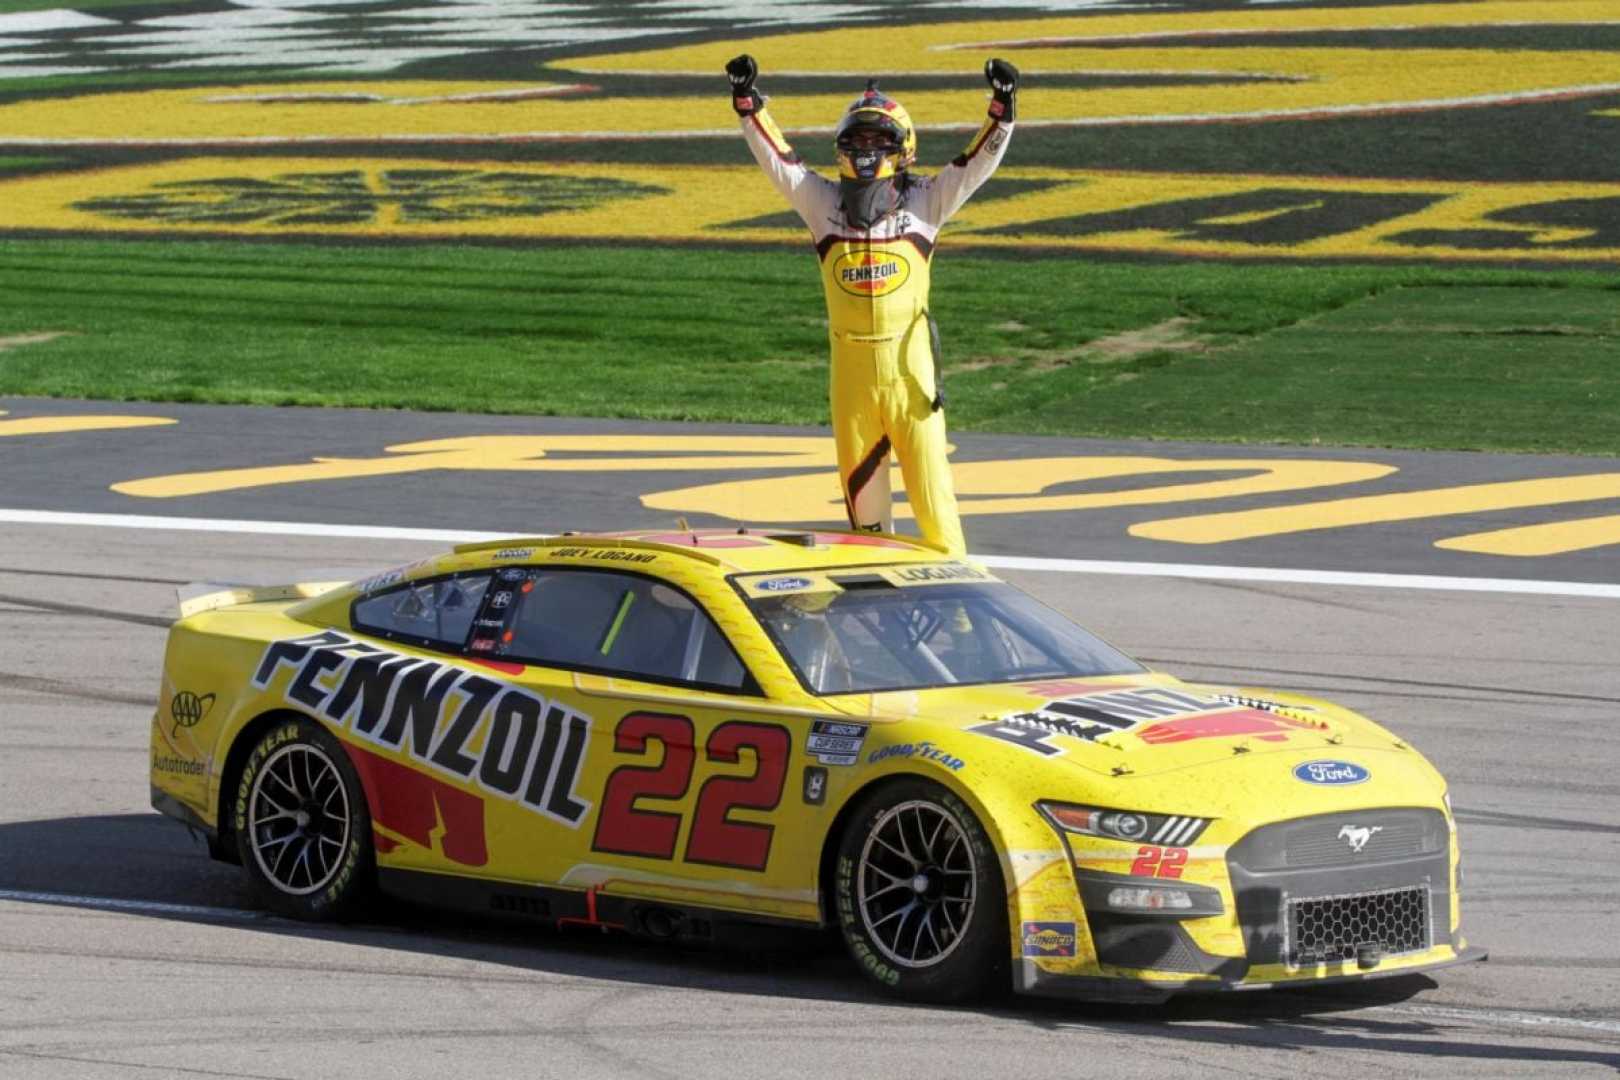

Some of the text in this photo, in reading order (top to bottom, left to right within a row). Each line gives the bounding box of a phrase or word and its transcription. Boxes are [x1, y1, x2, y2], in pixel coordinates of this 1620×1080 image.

[842, 262, 898, 282] PENNZOIL
[593, 551, 657, 563] LOGANO
[767, 578, 802, 591] Ford
[252, 629, 594, 828] PENNZOIL
[152, 753, 207, 776] Autotrader
[1306, 764, 1358, 781] Ford
[591, 710, 792, 873] 22
[1129, 846, 1189, 880] 22
[1026, 935, 1073, 947] SUNOCO
